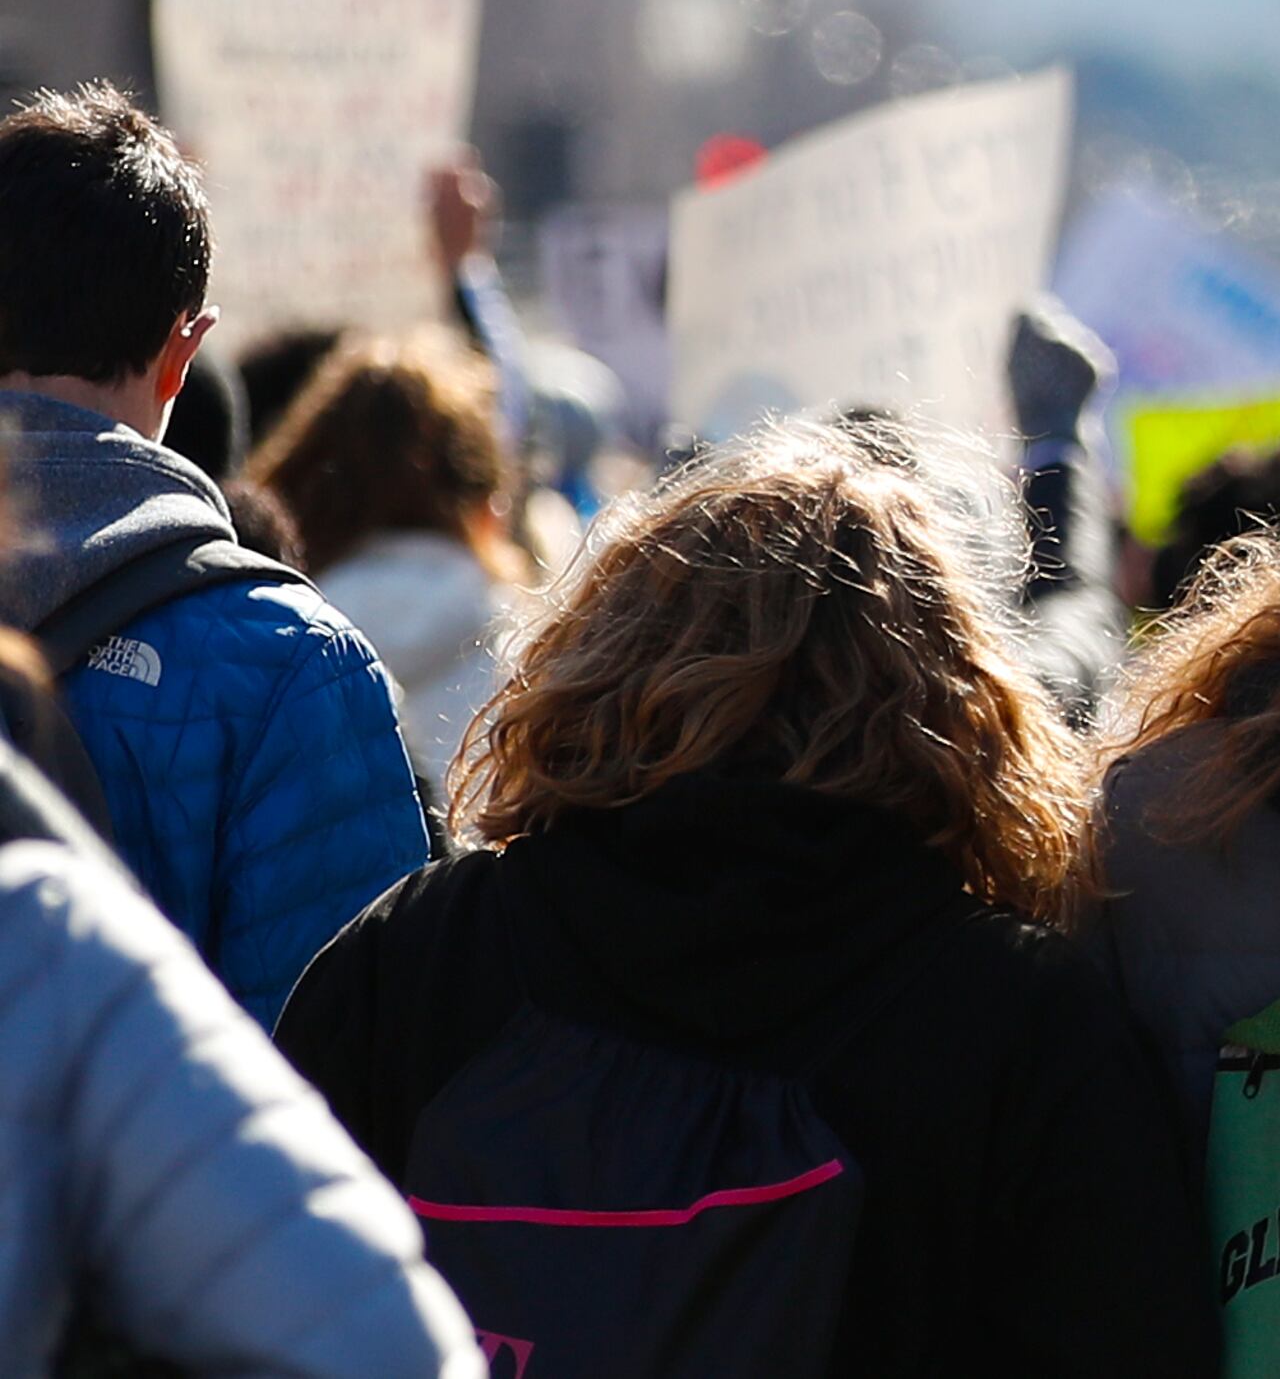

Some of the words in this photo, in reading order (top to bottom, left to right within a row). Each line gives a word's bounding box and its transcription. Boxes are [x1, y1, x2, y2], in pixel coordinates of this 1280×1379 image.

[108, 635, 139, 652] THE
[87, 645, 136, 665] ORTH
[87, 657, 130, 677] FACE
